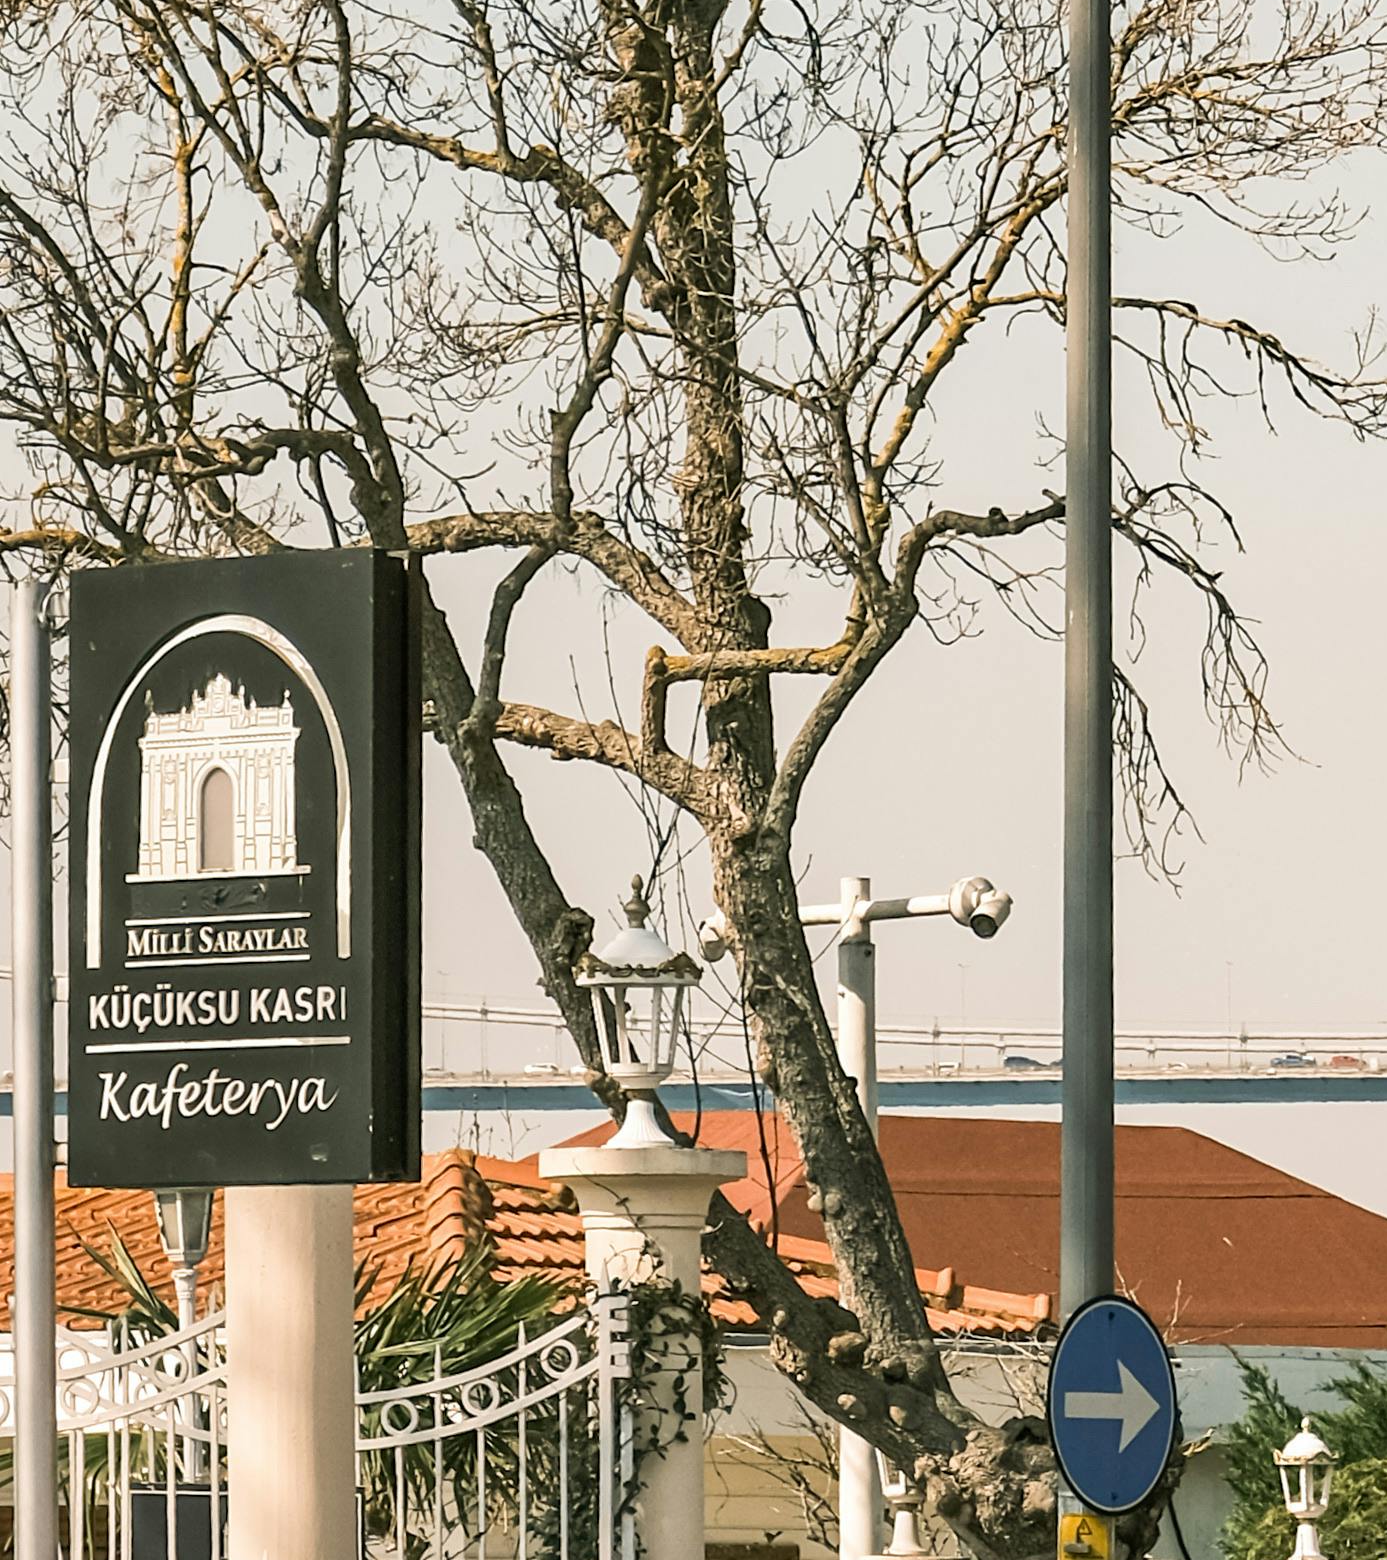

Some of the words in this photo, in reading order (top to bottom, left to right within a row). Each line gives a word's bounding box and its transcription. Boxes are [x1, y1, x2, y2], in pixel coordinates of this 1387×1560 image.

[199, 925, 310, 954] SARAYLAR
[88, 983, 240, 1033] KÜÇÜKSU
[249, 985, 347, 1023] KASRI
[98, 1062, 340, 1131] Kafeterya
